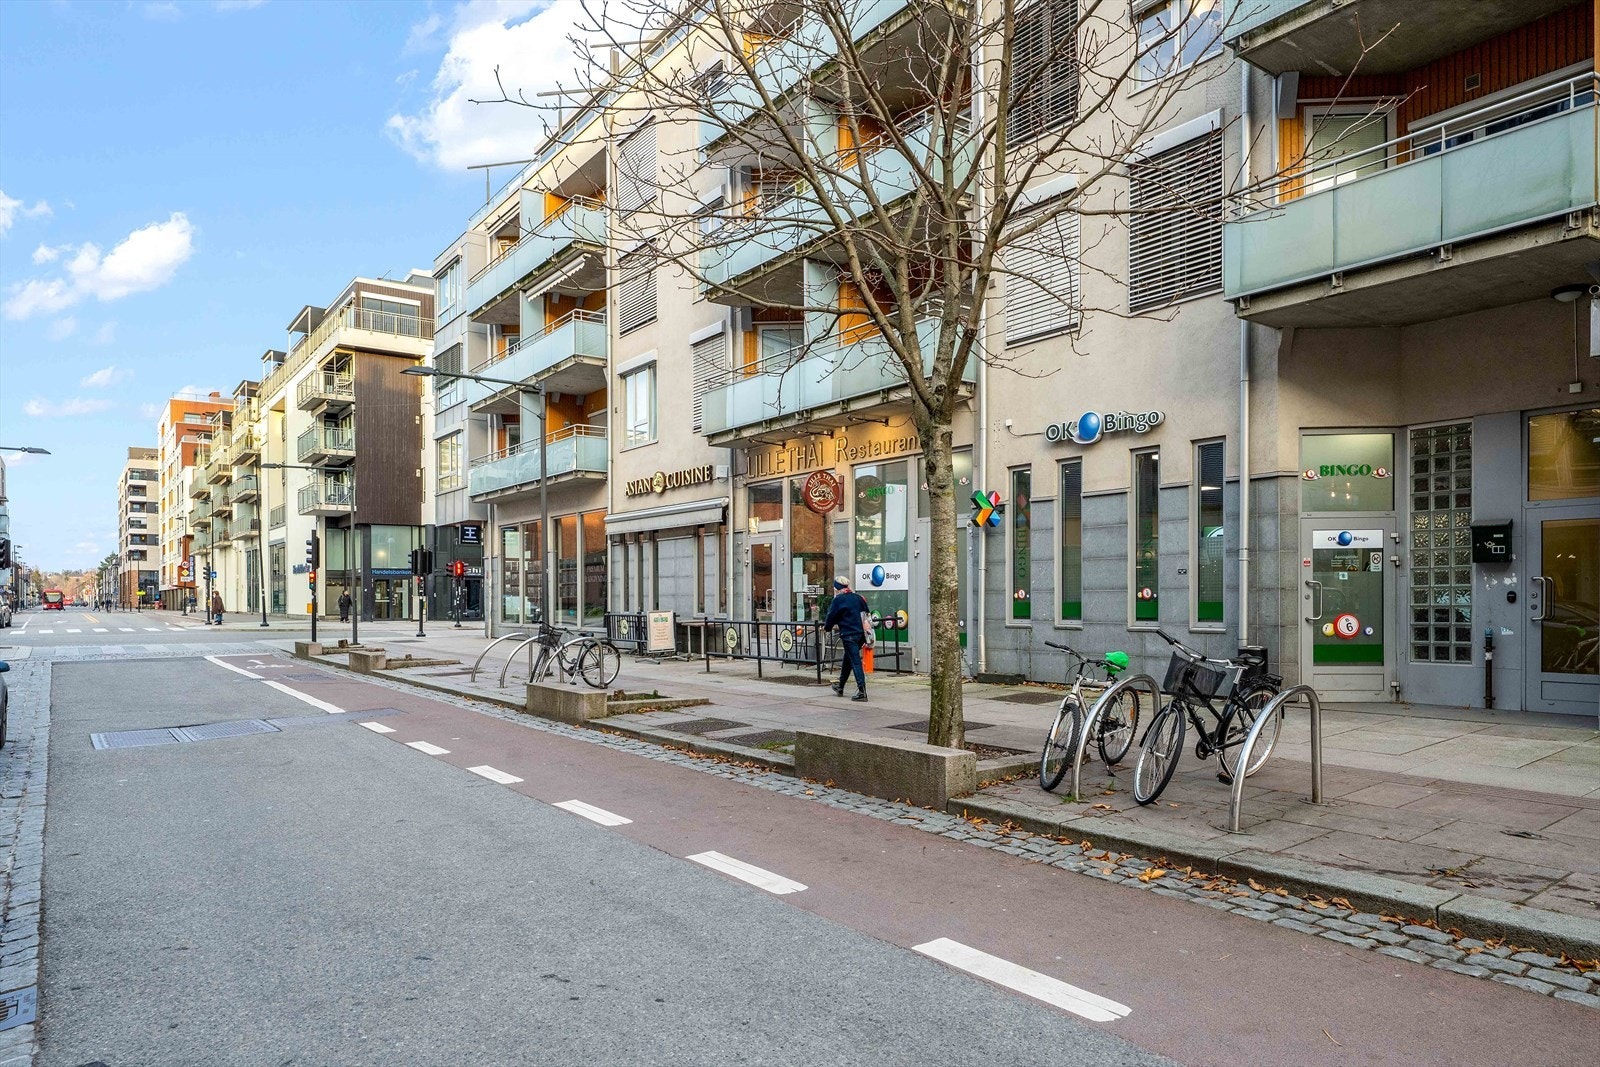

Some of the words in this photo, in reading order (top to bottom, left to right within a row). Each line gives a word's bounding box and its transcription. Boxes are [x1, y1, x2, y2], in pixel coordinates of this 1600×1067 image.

[1045, 421, 1074, 441] OK
[1103, 411, 1160, 432] Bingo
[836, 435, 919, 463] Restauran
[1319, 464, 1371, 477] BINGO
[624, 477, 654, 496] ASIAN
[665, 465, 713, 489] CUISINE
[808, 473, 821, 487] LILLE
[822, 473, 836, 487] THAI
[886, 572, 901, 580] Bingo
[1346, 622, 1353, 632] 6
